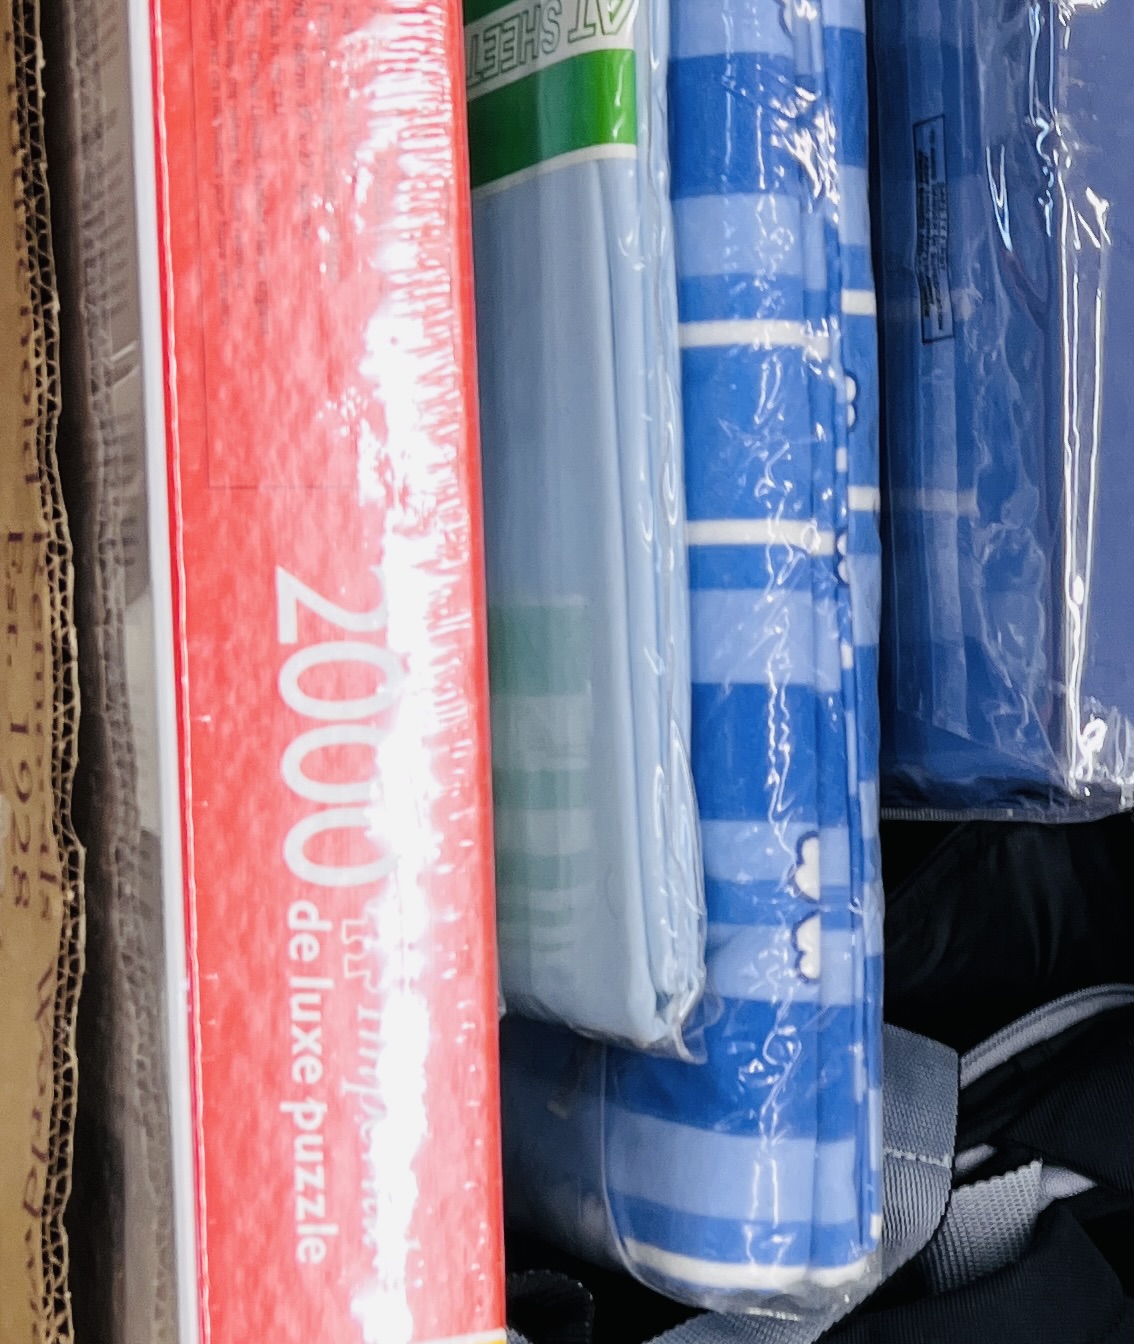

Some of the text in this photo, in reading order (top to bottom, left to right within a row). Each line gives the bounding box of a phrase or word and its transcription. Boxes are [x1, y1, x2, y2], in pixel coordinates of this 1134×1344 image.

[274, 561, 408, 888] 2000
[281, 899, 336, 1265] de luxe puzzle
